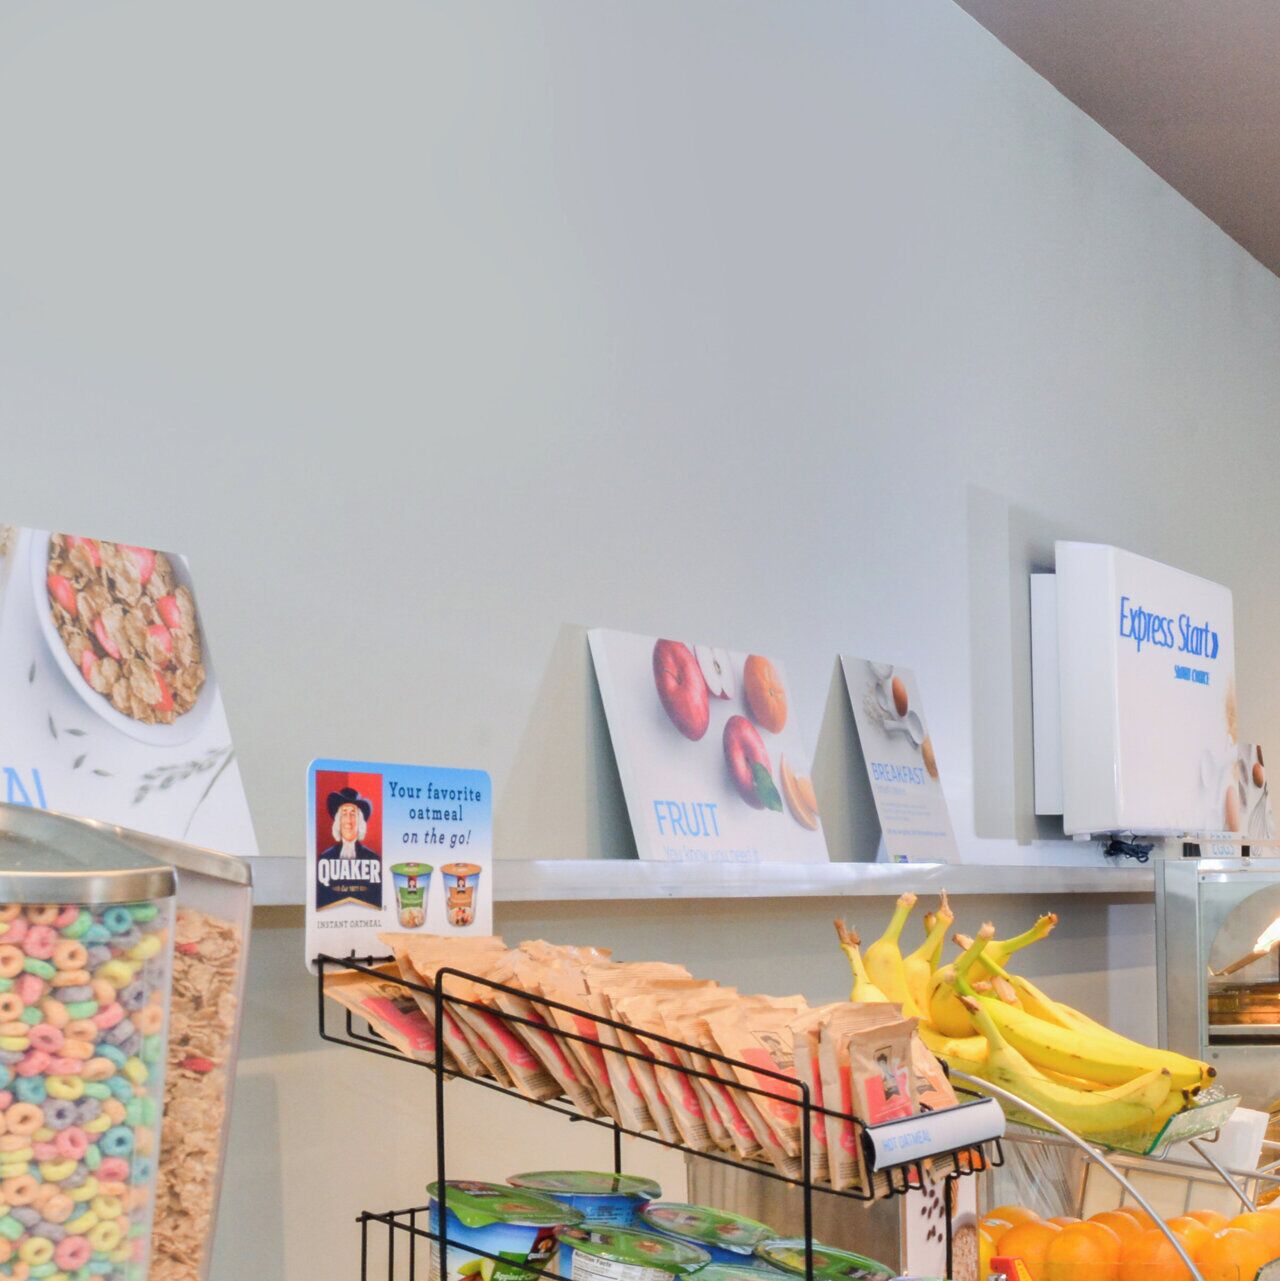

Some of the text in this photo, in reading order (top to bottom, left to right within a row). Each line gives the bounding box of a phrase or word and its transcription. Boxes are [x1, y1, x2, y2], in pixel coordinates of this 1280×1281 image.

[1120, 596, 1210, 658] Express Start
[871, 761, 925, 785] BREAKFAST
[389, 781, 482, 802] Your favorite
[409, 805, 463, 822] oatmeal
[653, 799, 720, 837] FRUIT
[402, 827, 472, 849] on the go!
[318, 859, 382, 887] QUAKER
[317, 919, 382, 929] INSTANT OATMEAL
